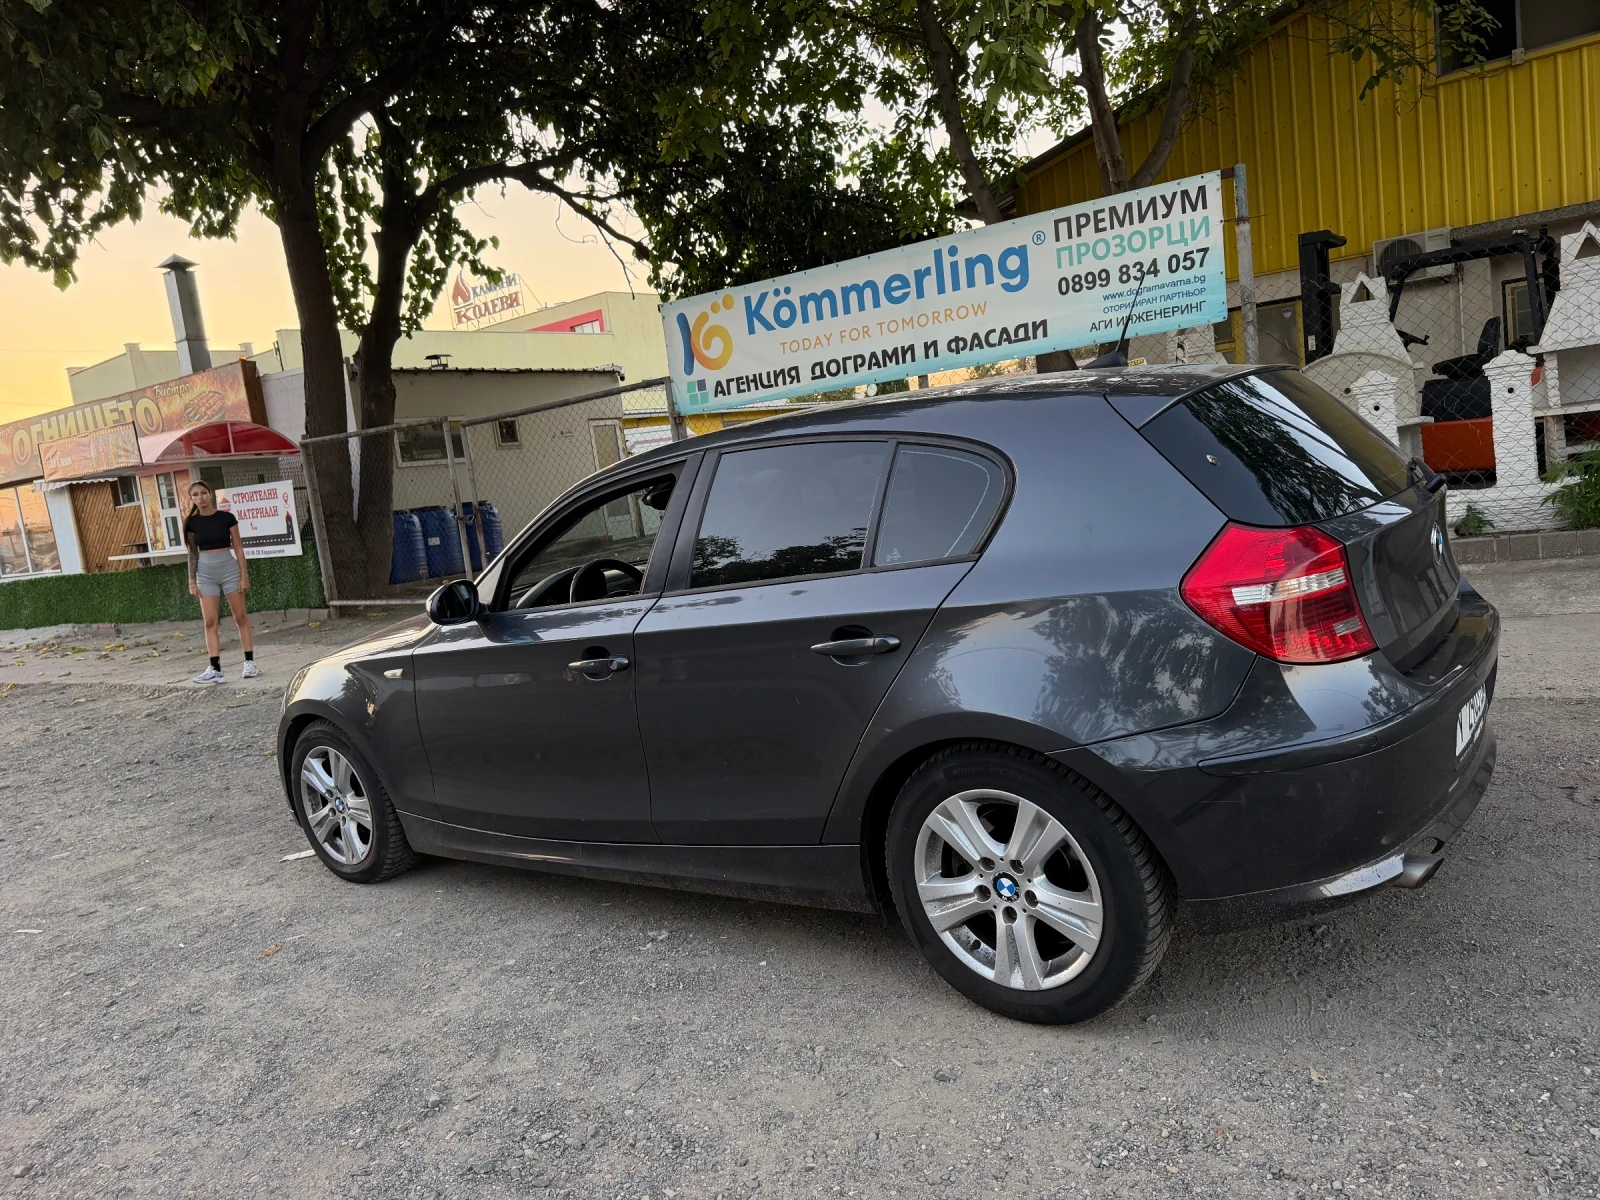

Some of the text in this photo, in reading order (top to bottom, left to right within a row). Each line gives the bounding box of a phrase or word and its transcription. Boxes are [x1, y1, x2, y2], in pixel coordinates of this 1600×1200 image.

[1053, 185, 1208, 243] ПРЕМИУМ
[1056, 216, 1211, 269] ПРОЗОРЦИ
[1057, 247, 1210, 296] 0899 834 057
[1102, 273, 1207, 301] www.dogramavarna.bg
[455, 291, 521, 325] КОЛЕВИ
[1089, 300, 1208, 333] АГИ ИНЖЕНЕРИНГ
[1102, 287, 1207, 315] ОТОРИЗИРАН ПАРТНЬОР
[780, 301, 988, 355] TODAY FOR TOMORROW
[714, 318, 1049, 398] АГЕНЦИЯ ДОГРАМИ И ФАСАДИ
[153, 382, 191, 400] Бистро
[232, 488, 278, 504] СТРОИТЕЛНИ
[237, 505, 279, 521] МАТЕРИАЛИ
